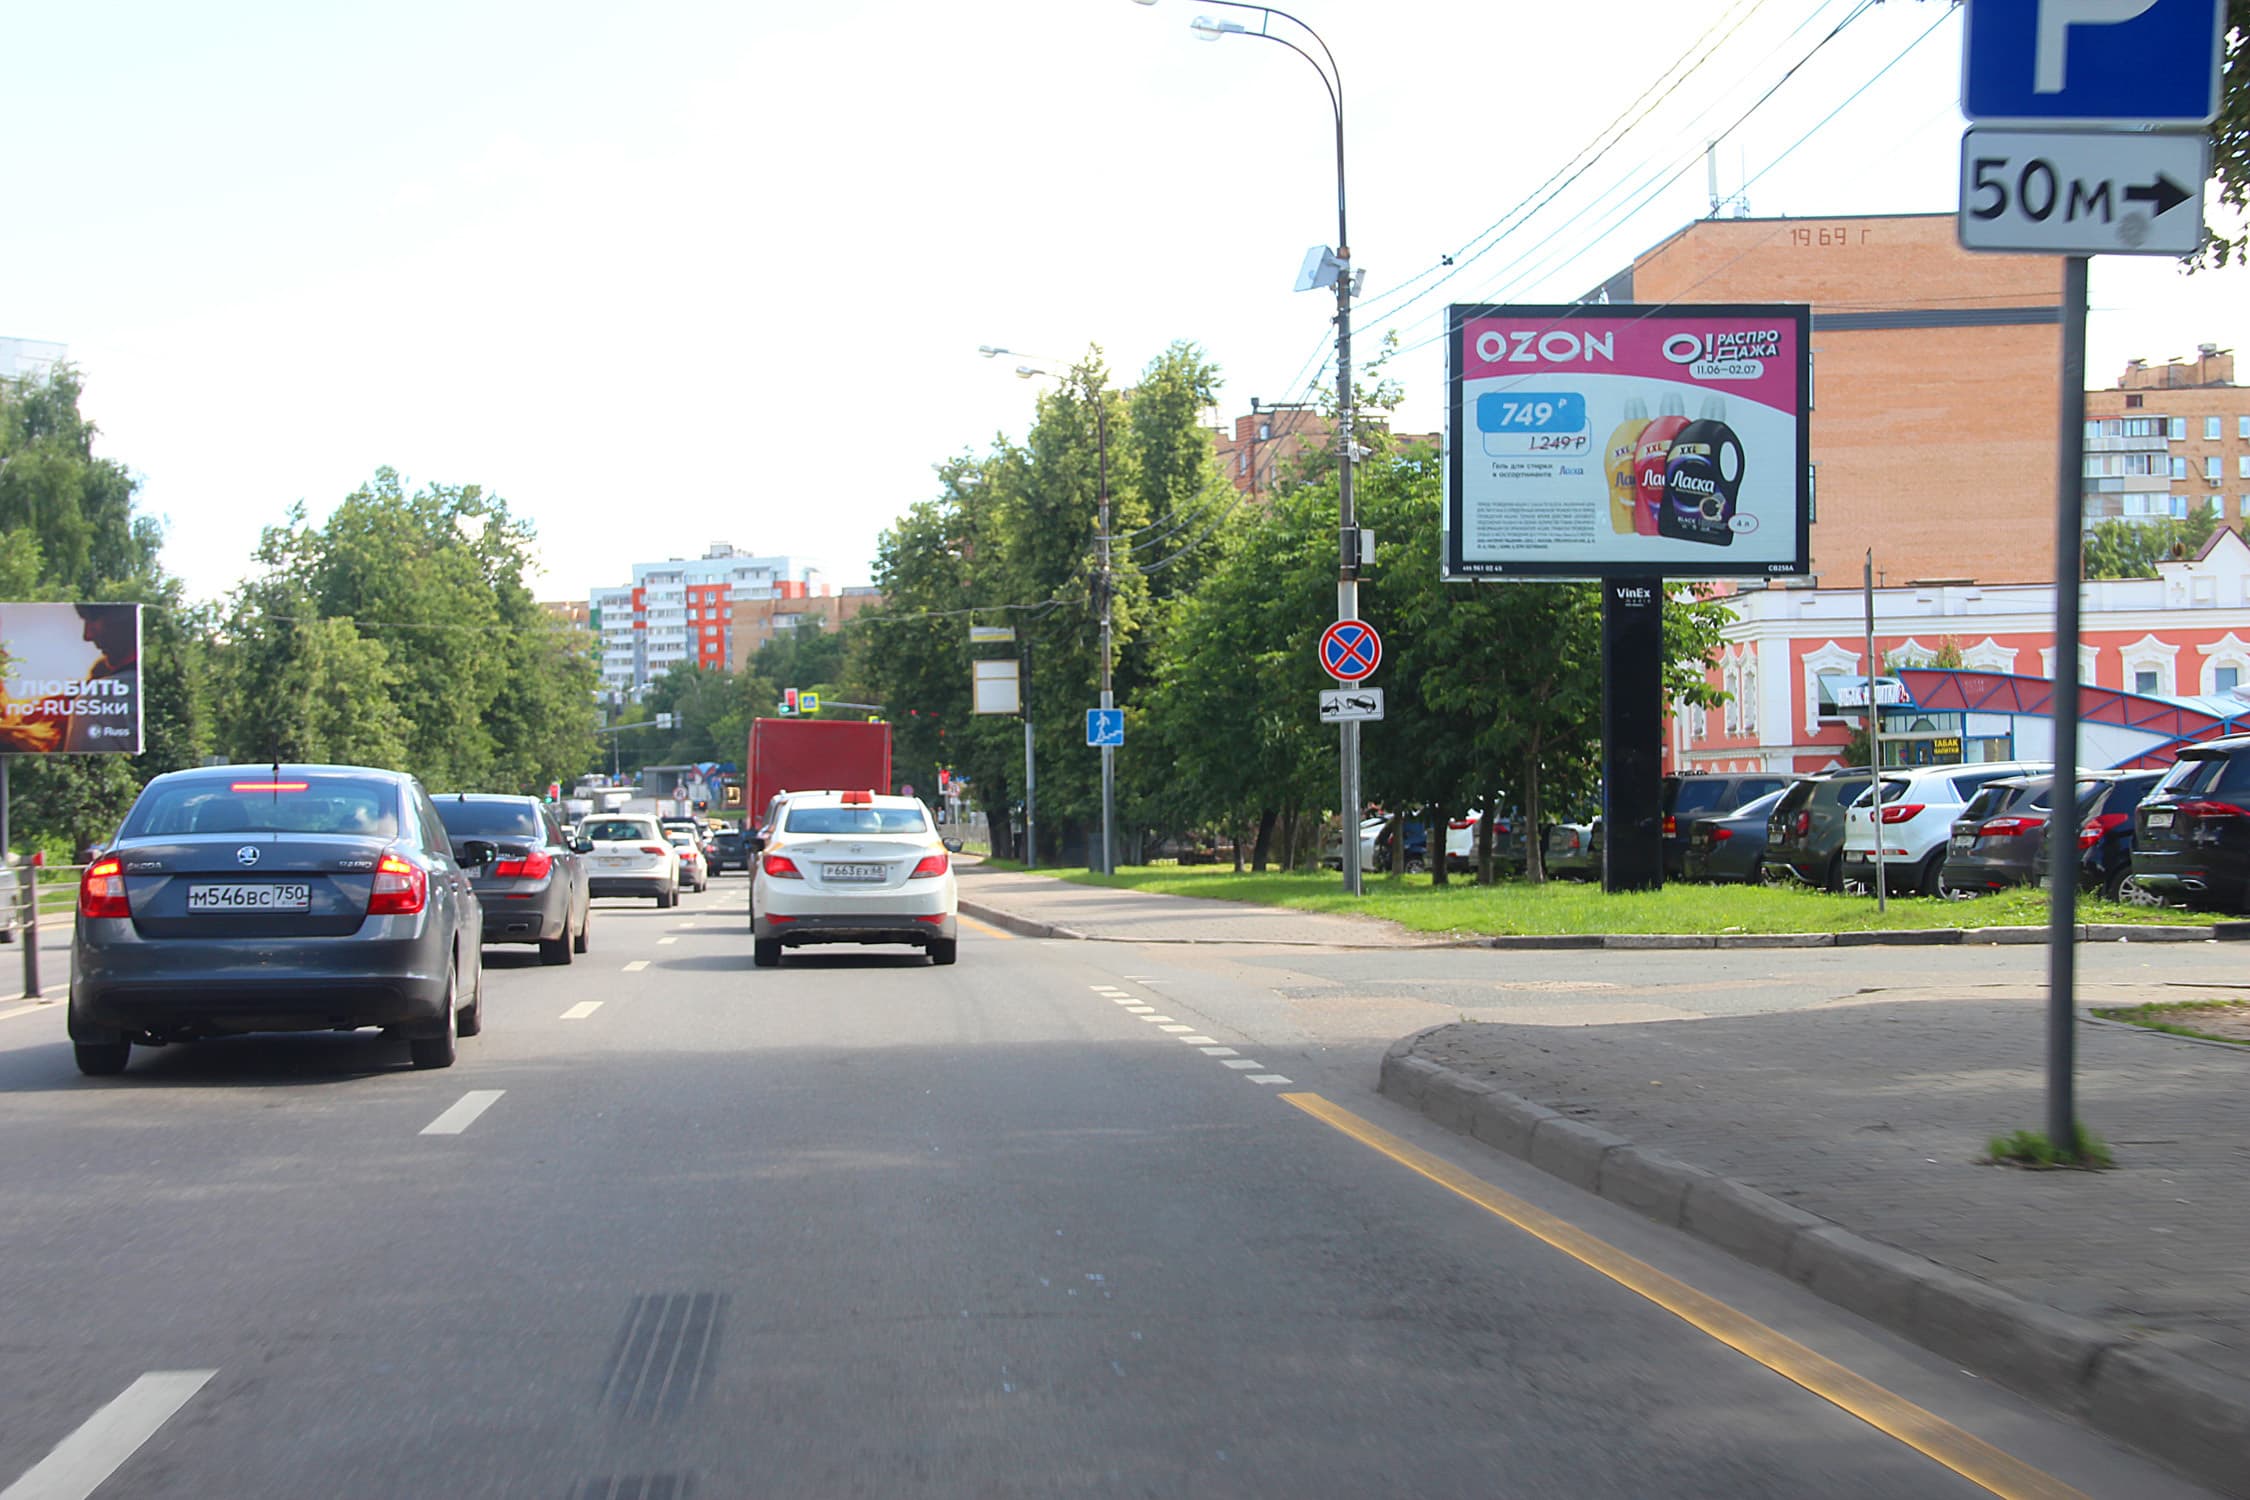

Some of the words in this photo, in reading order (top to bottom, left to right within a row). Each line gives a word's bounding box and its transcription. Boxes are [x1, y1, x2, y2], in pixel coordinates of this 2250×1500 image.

[1791, 227, 1846, 246] 1969
[1476, 331, 1614, 362] OZON
[1718, 330, 1779, 346] РАСПРО
[1716, 343, 1778, 361] ДАЖА
[1501, 402, 1553, 426] 749
[1670, 470, 1714, 494] Ласка
[18, 680, 129, 697] ЛЮБИТЬ
[275, 886, 305, 900] 750
